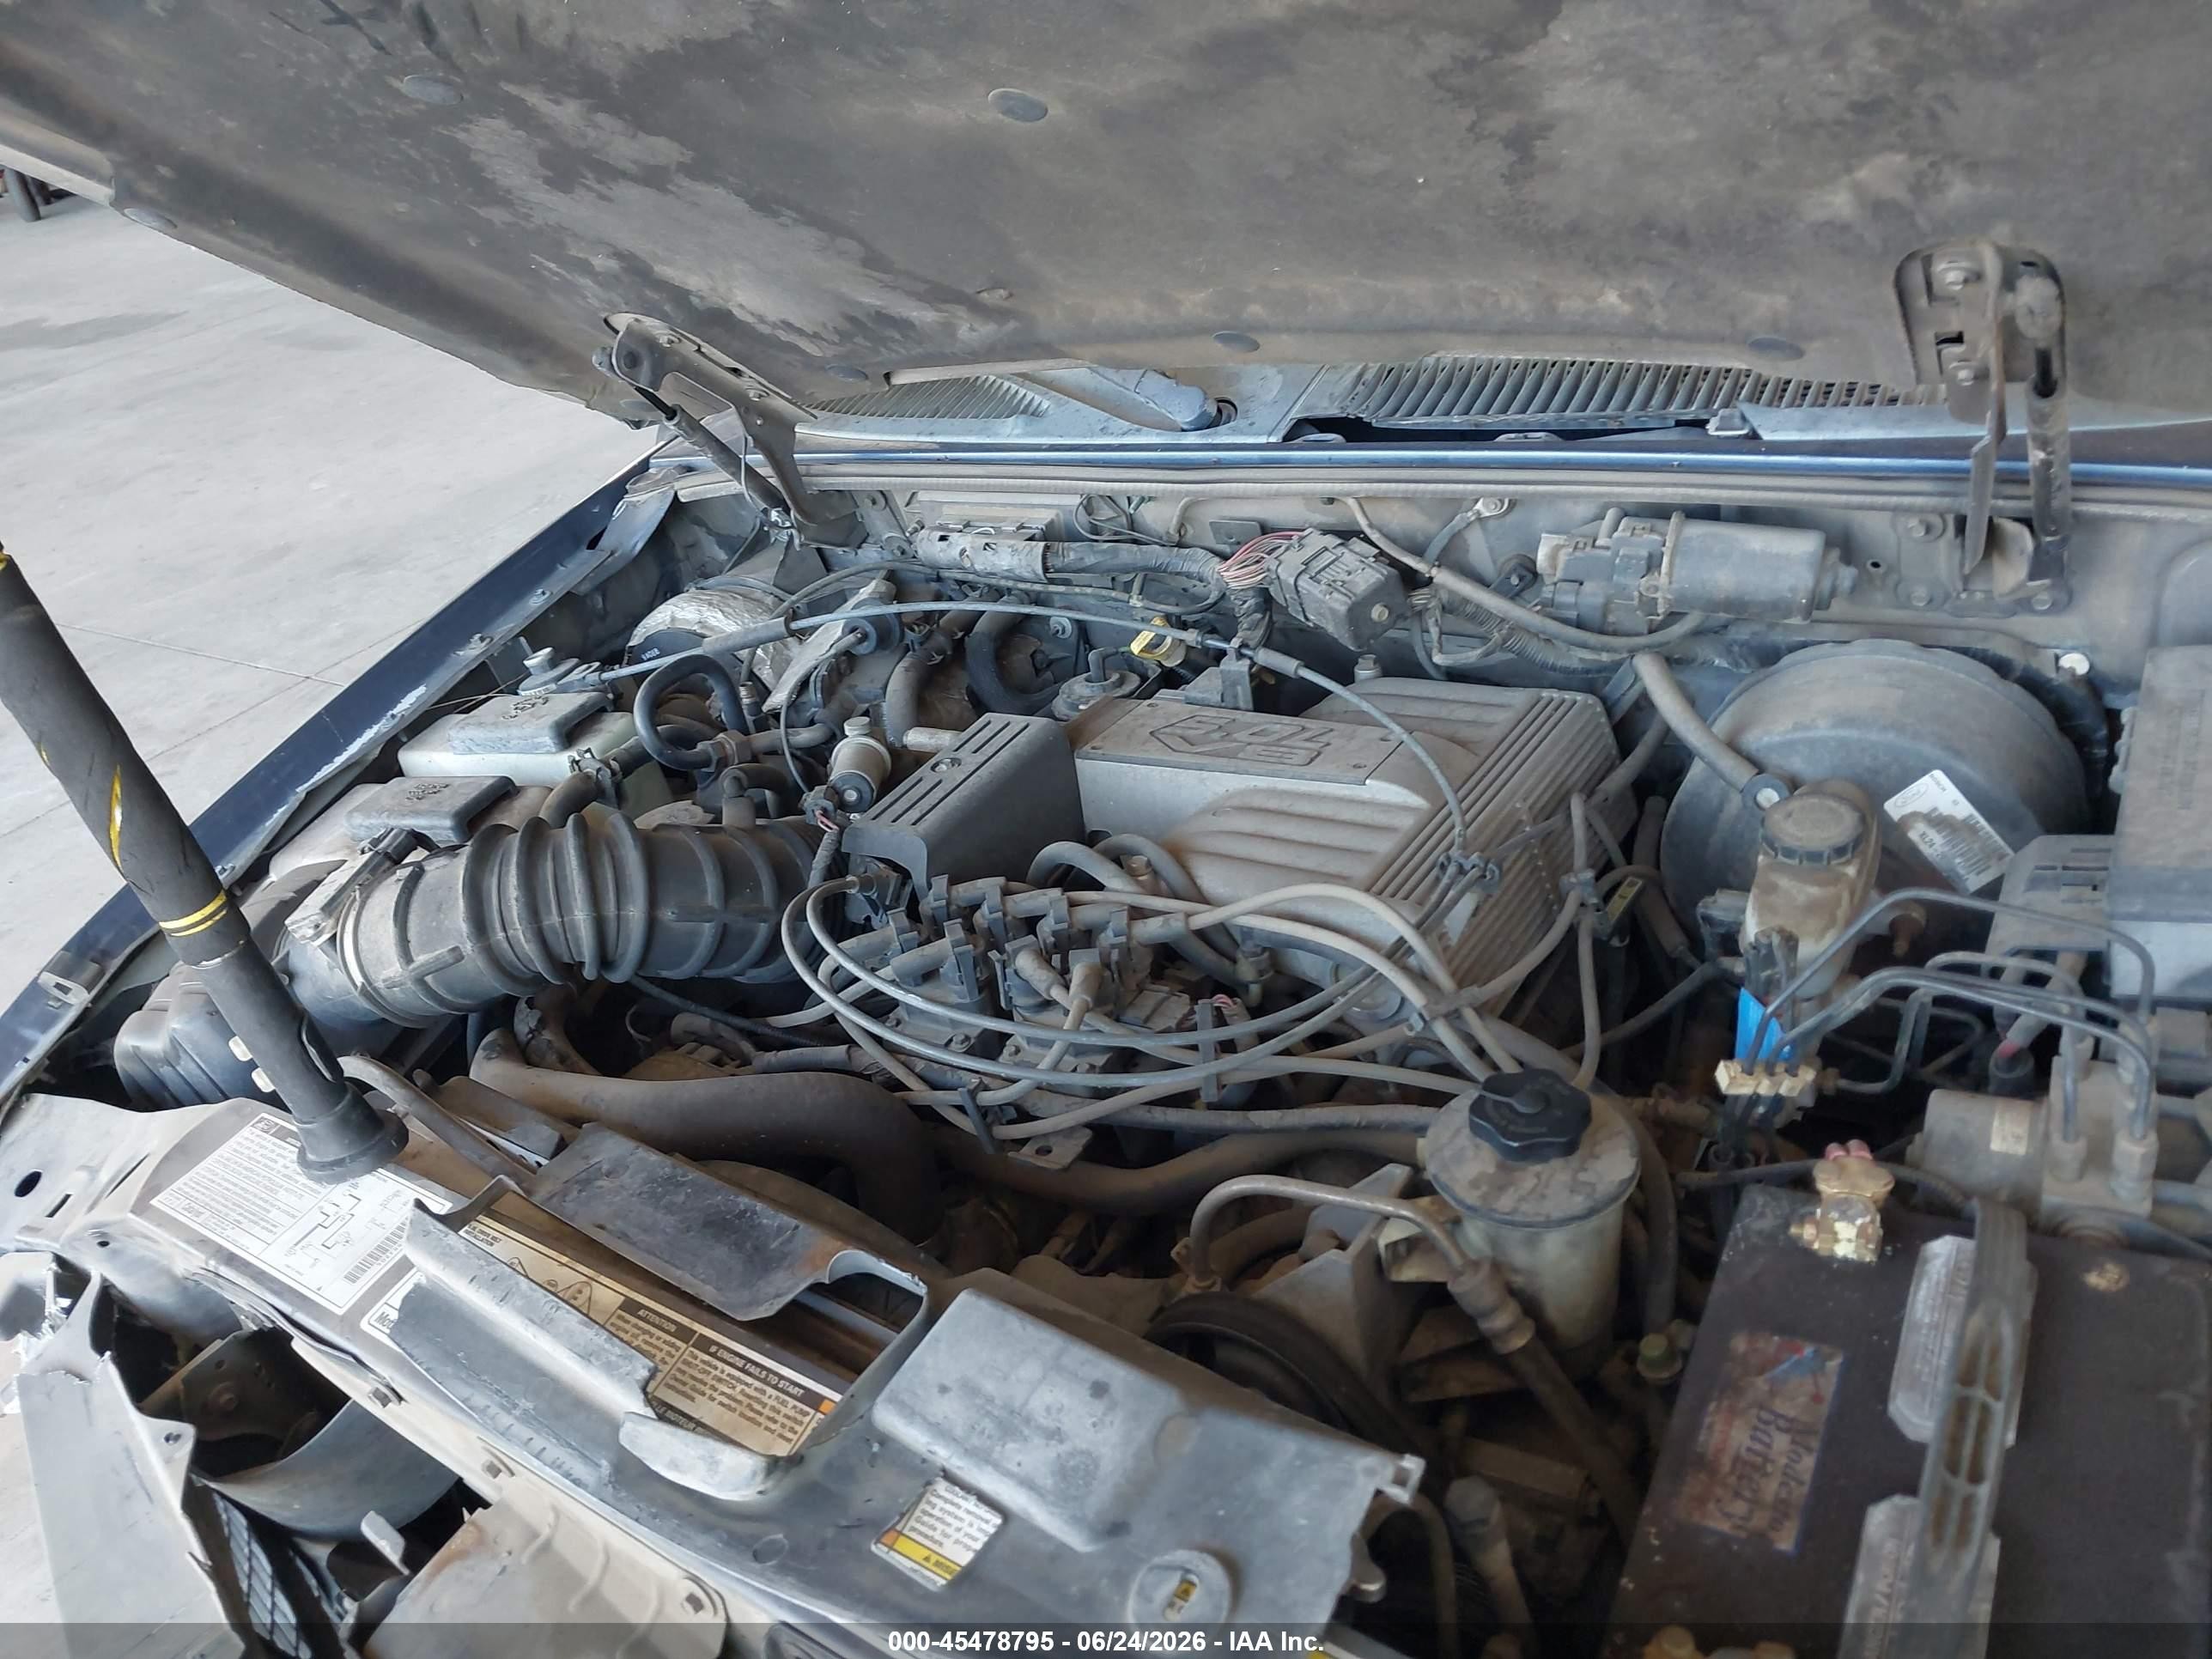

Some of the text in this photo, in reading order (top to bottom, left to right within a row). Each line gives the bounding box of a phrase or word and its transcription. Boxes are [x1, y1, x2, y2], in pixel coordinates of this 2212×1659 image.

[635, 1308, 678, 1332] ATTENTION
[698, 1357, 720, 1370] vehicle
[724, 1370, 754, 1389] equipped
[772, 1395, 791, 1407] FUEL
[789, 1403, 811, 1419] PUMP
[708, 1344, 805, 1397] IF ENGINE FAILS TO START
